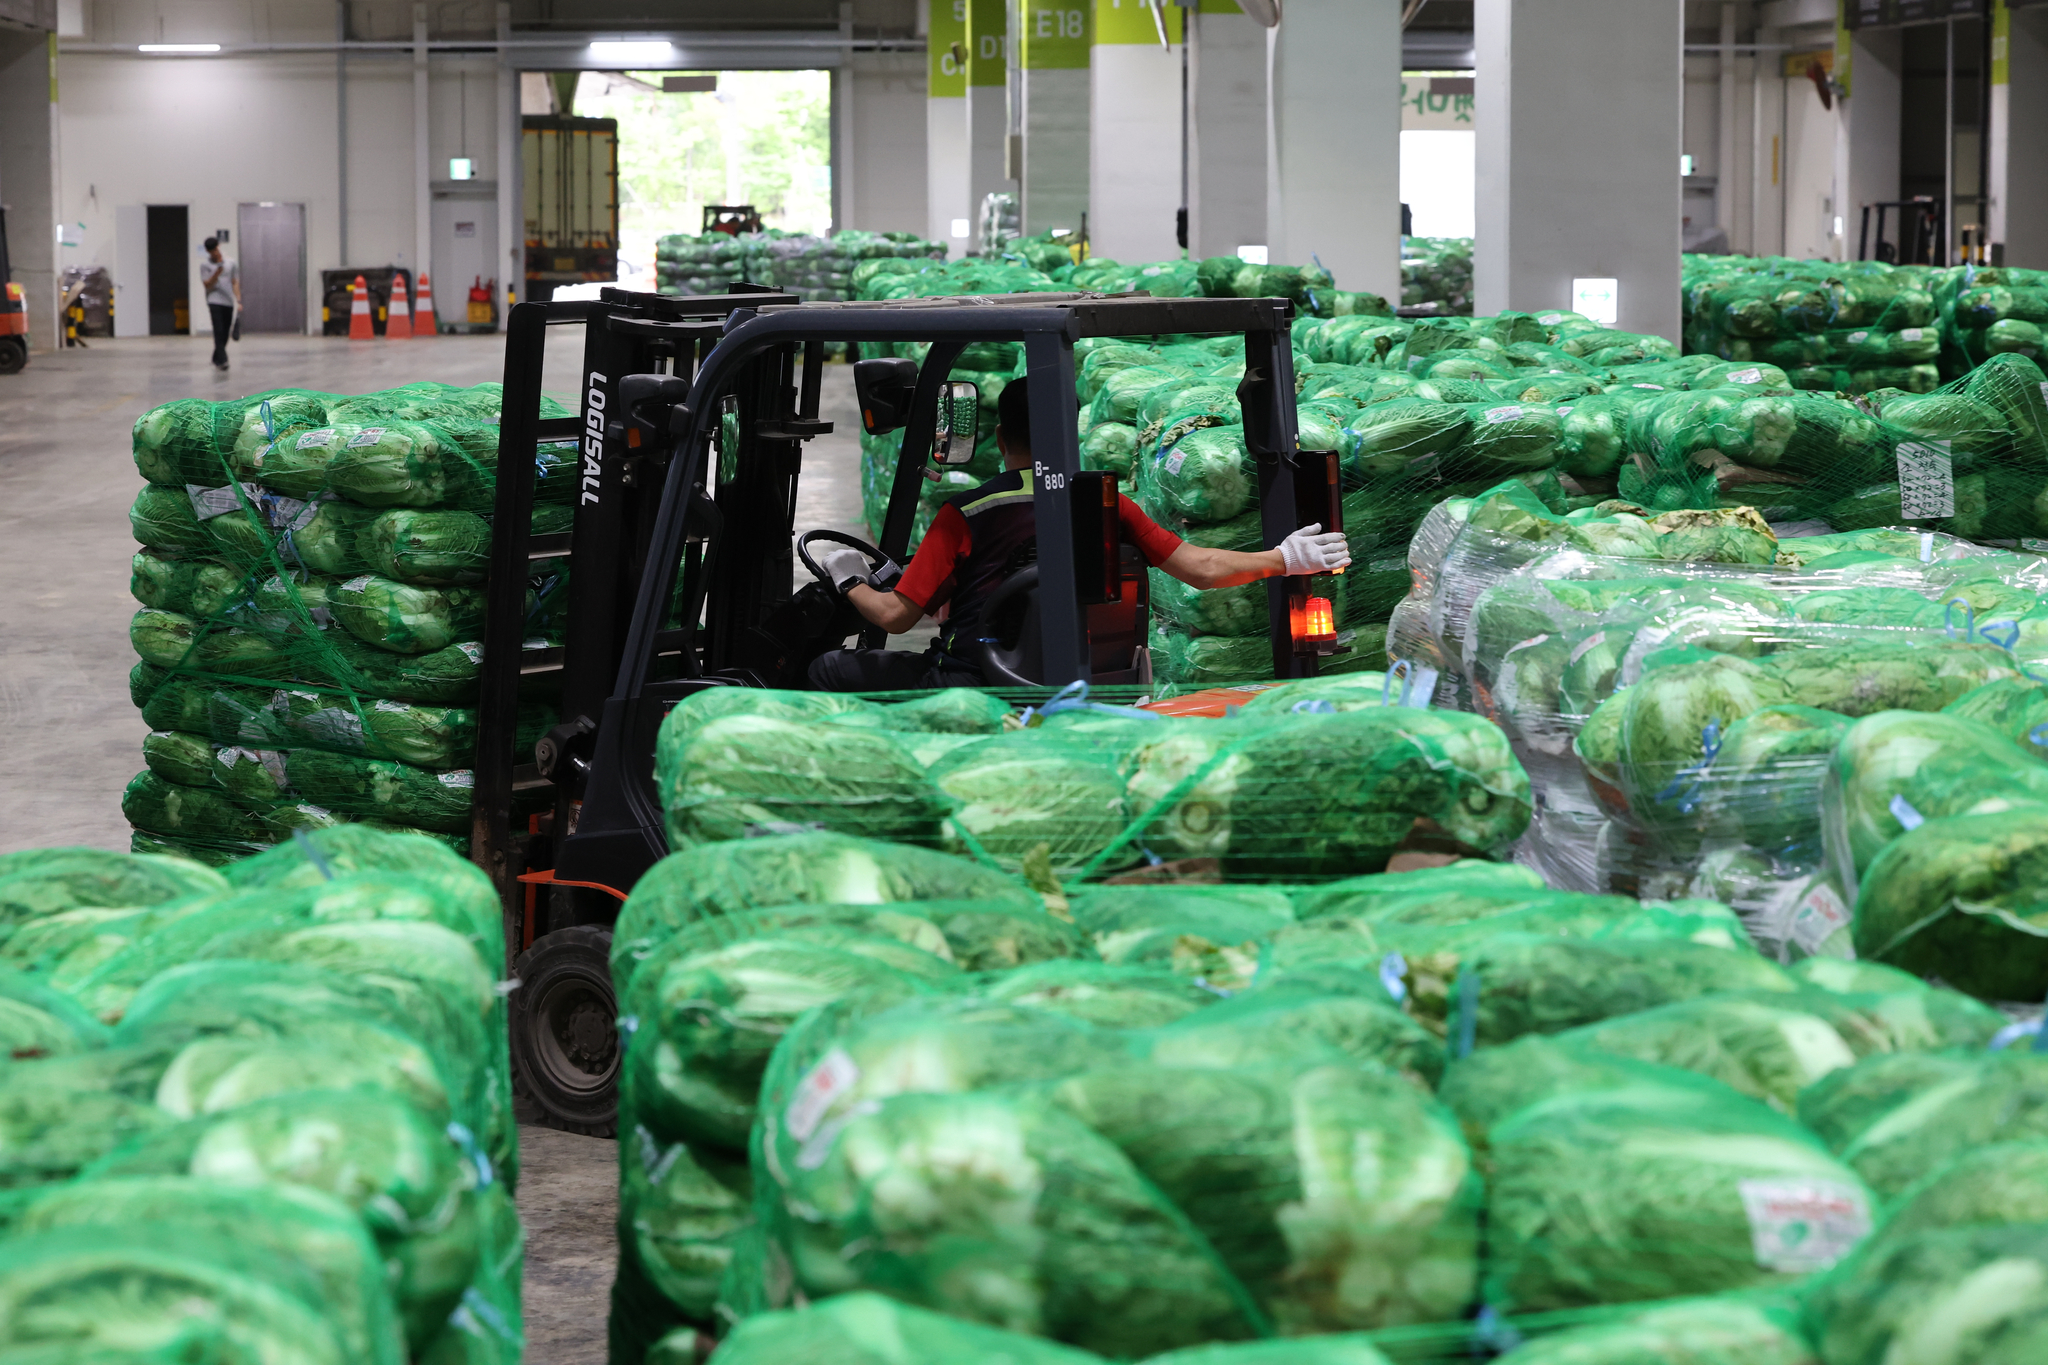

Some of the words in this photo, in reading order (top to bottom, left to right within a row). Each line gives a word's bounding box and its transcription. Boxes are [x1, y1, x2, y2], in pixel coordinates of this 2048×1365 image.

[1036, 9, 1083, 38] E18
[581, 371, 607, 506] LOGISALL
[1035, 460, 1050, 477] B-
[1044, 472, 1065, 490] 880
